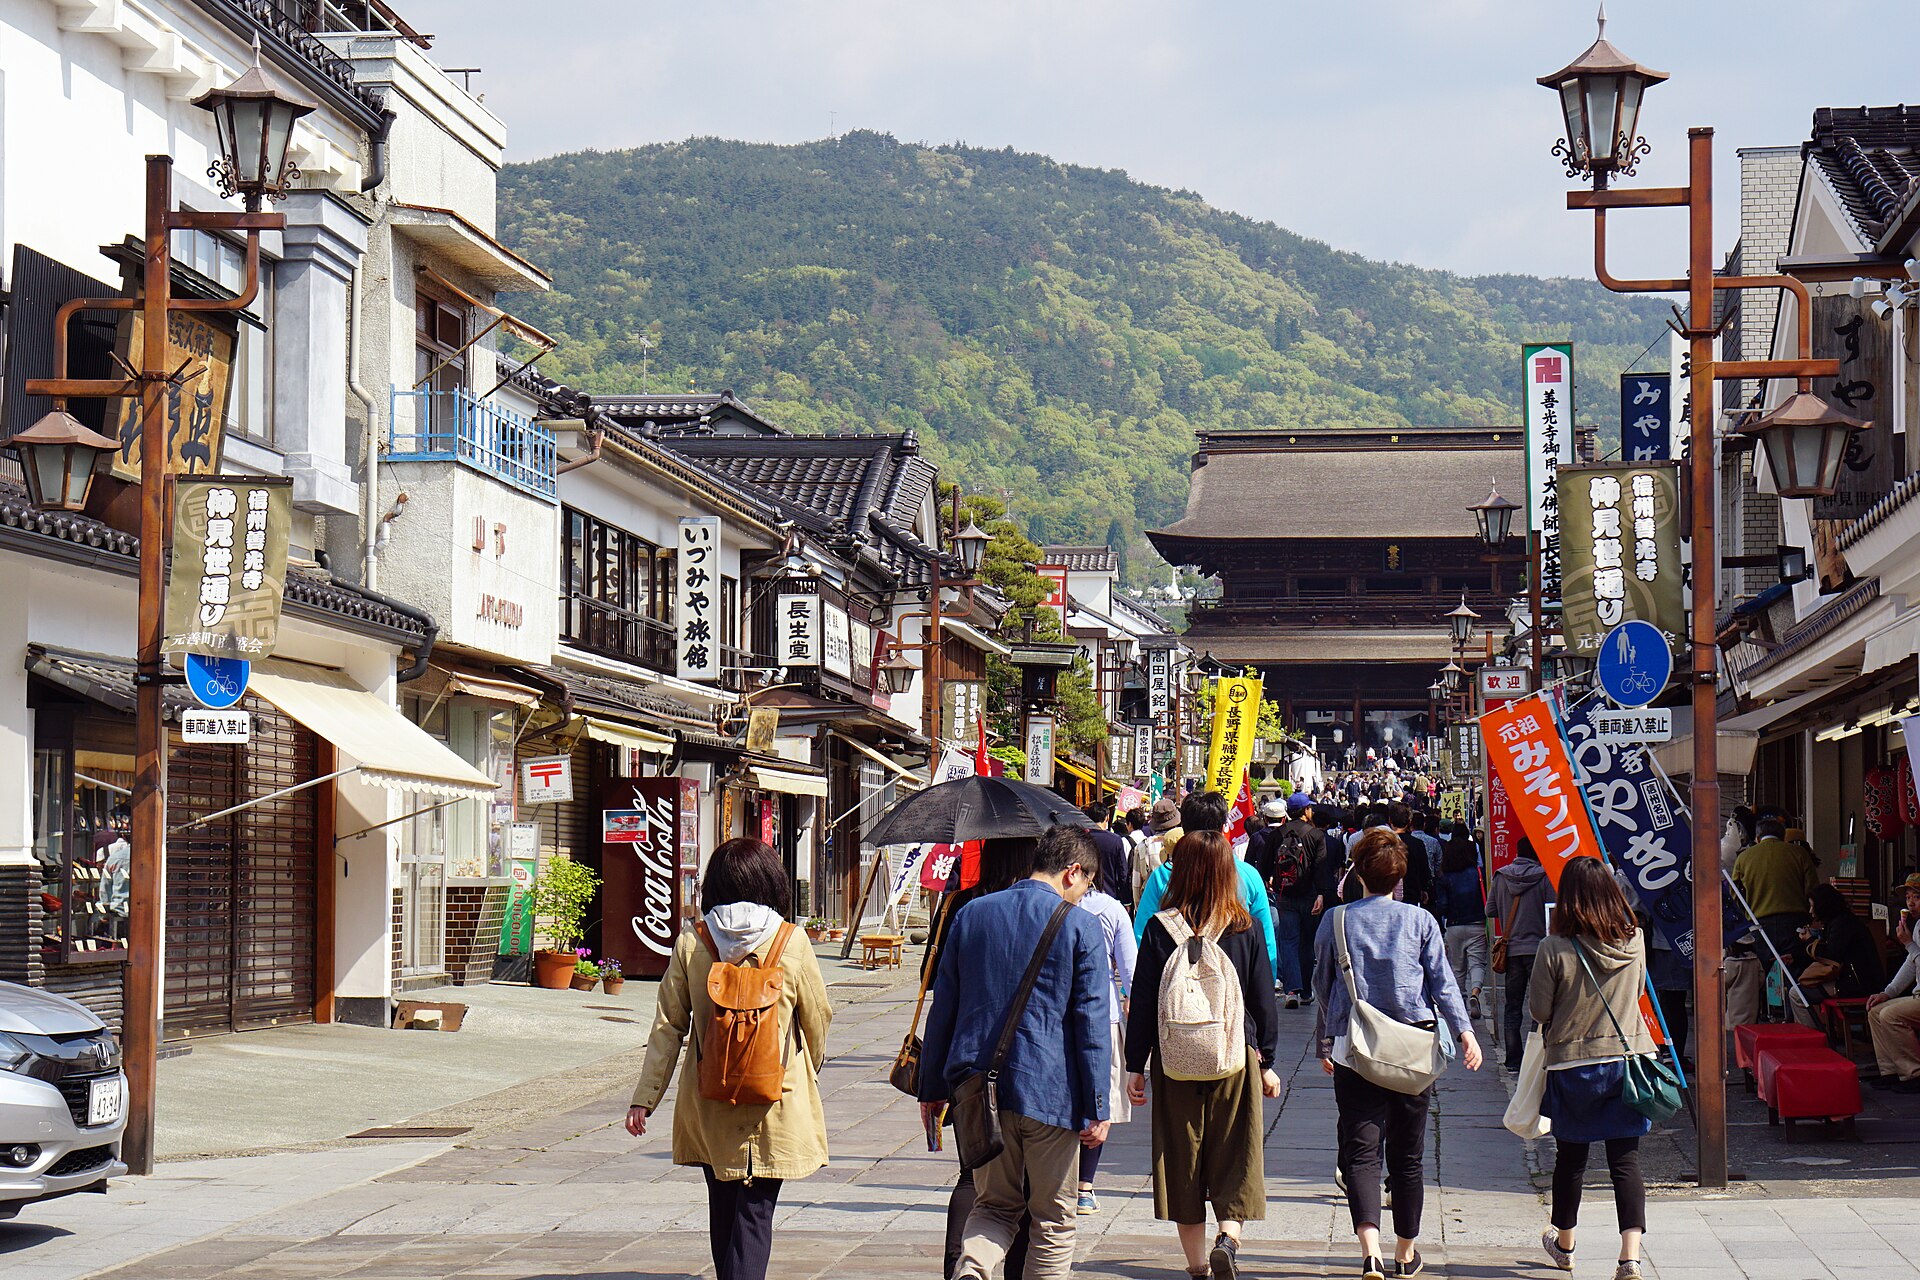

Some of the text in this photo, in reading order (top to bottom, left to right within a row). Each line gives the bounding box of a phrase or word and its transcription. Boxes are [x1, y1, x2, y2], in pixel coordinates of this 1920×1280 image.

[199, 488, 237, 627] 仲見世通り
[241, 490, 270, 590] 信州善光寺
[1589, 476, 1626, 627] 仲見世通り
[1632, 475, 1659, 582] 信州善光寺
[683, 528, 712, 669] いづみや旅館
[787, 601, 811, 660] 長生堂
[1487, 676, 1520, 689] 歓迎
[185, 718, 247, 735] 車両進入禁止
[1030, 734, 1042, 777] 松屋旅館
[1497, 714, 1541, 744] 元祖
[1599, 717, 1668, 735] 車両進入禁止
[1646, 784, 1668, 825] 信州名物
[510, 884, 524, 956] FUJICOLOR
